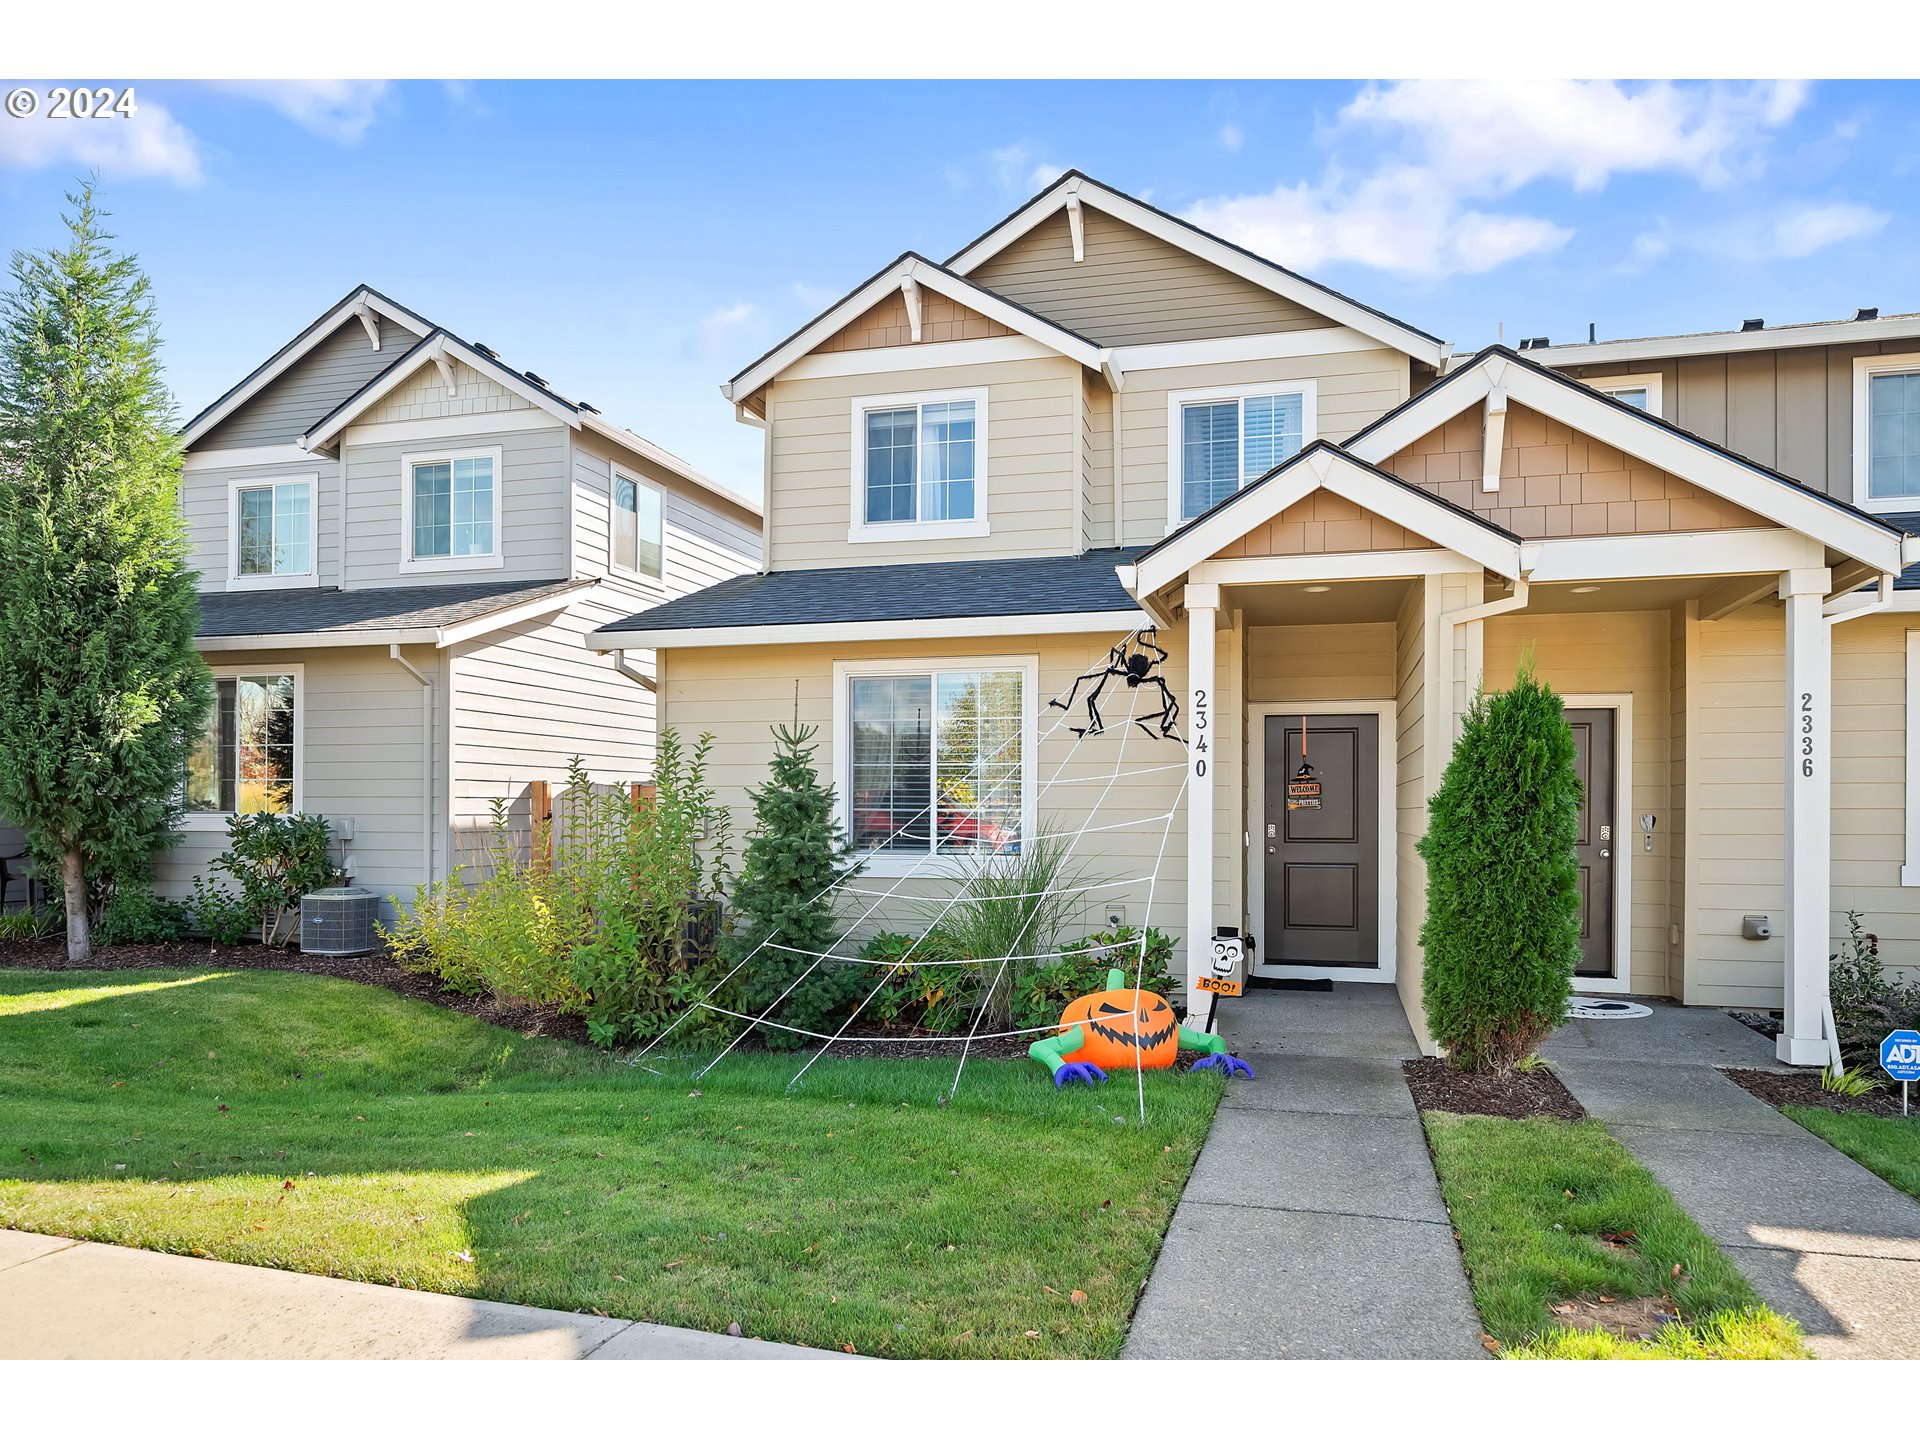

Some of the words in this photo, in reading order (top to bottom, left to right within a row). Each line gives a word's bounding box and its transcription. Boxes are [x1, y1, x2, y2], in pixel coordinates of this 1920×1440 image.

[1195, 690, 1208, 777] 2340
[1801, 693, 1813, 777] 2336
[1290, 785, 1319, 794] WELCOME
[1203, 978, 1236, 993] BOO!
[1885, 1044, 1920, 1064] ADT
